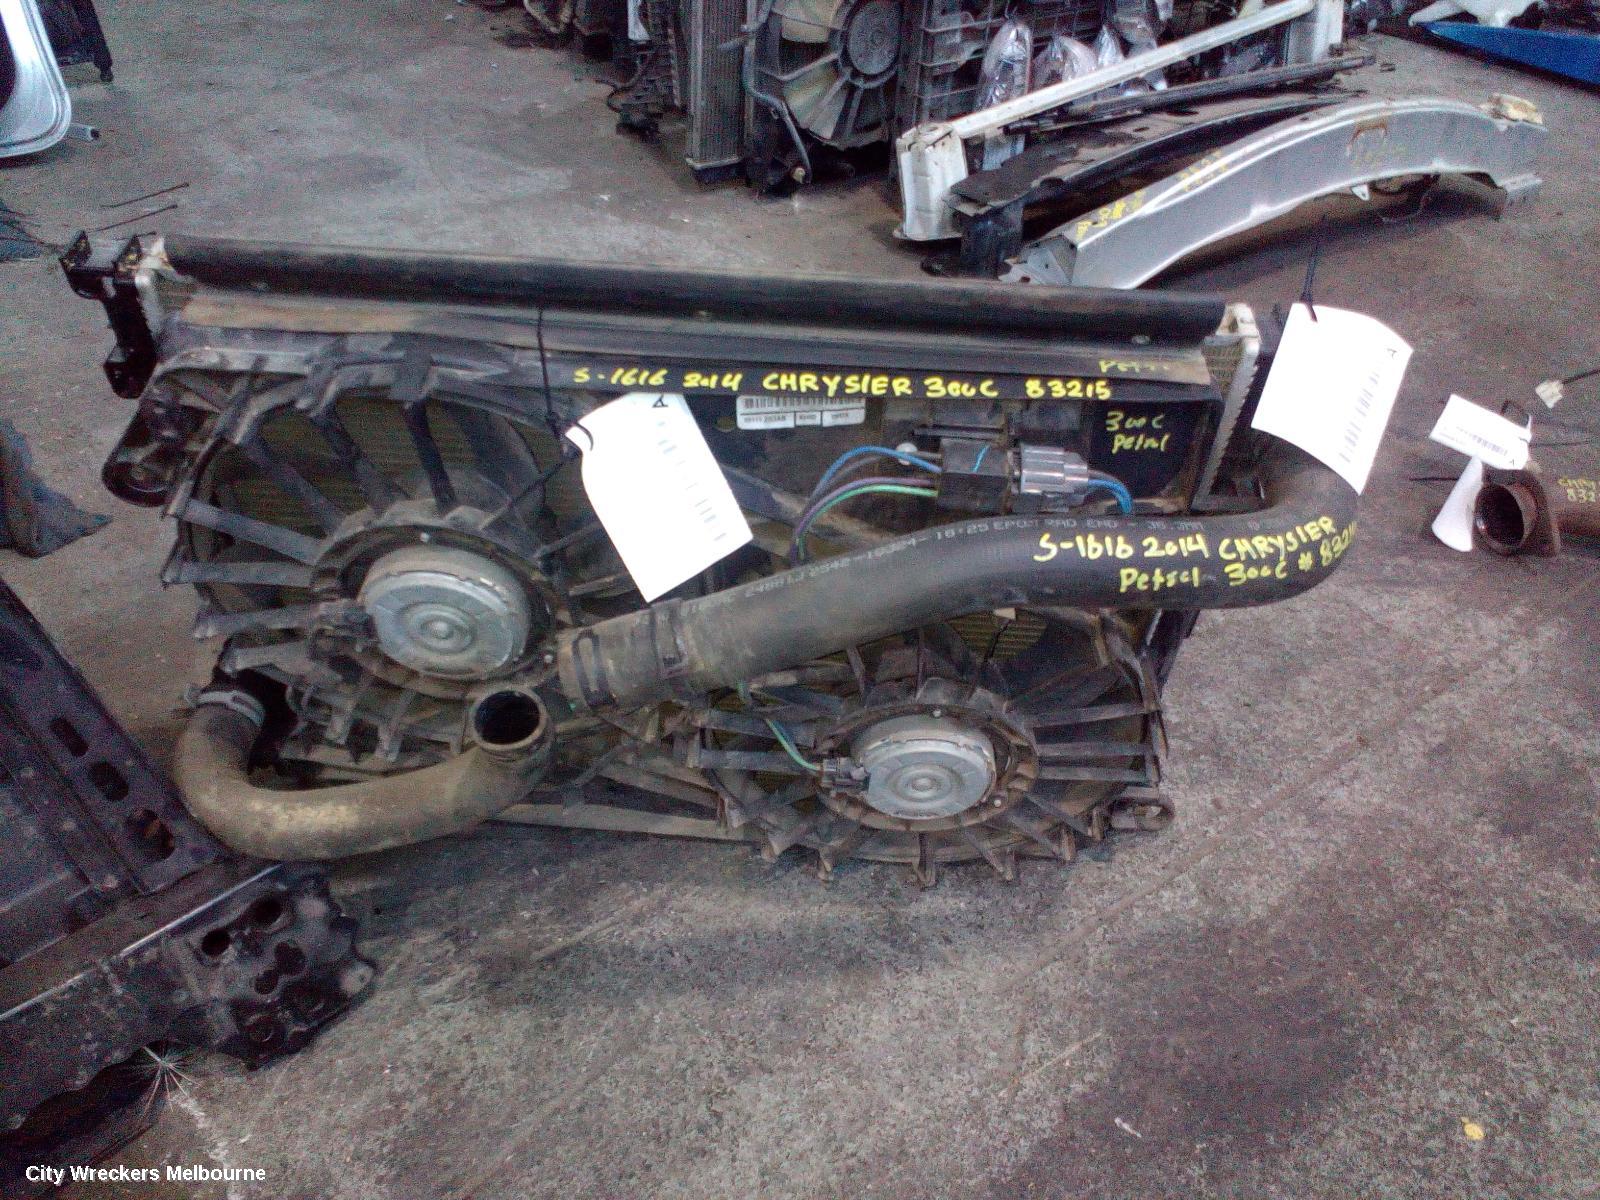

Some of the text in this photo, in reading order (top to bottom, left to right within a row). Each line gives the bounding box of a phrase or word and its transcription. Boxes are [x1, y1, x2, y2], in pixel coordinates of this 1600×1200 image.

[1025, 378, 1112, 400] 83215
[1033, 533, 1134, 562] S-1616
[1142, 533, 1210, 559] 2014
